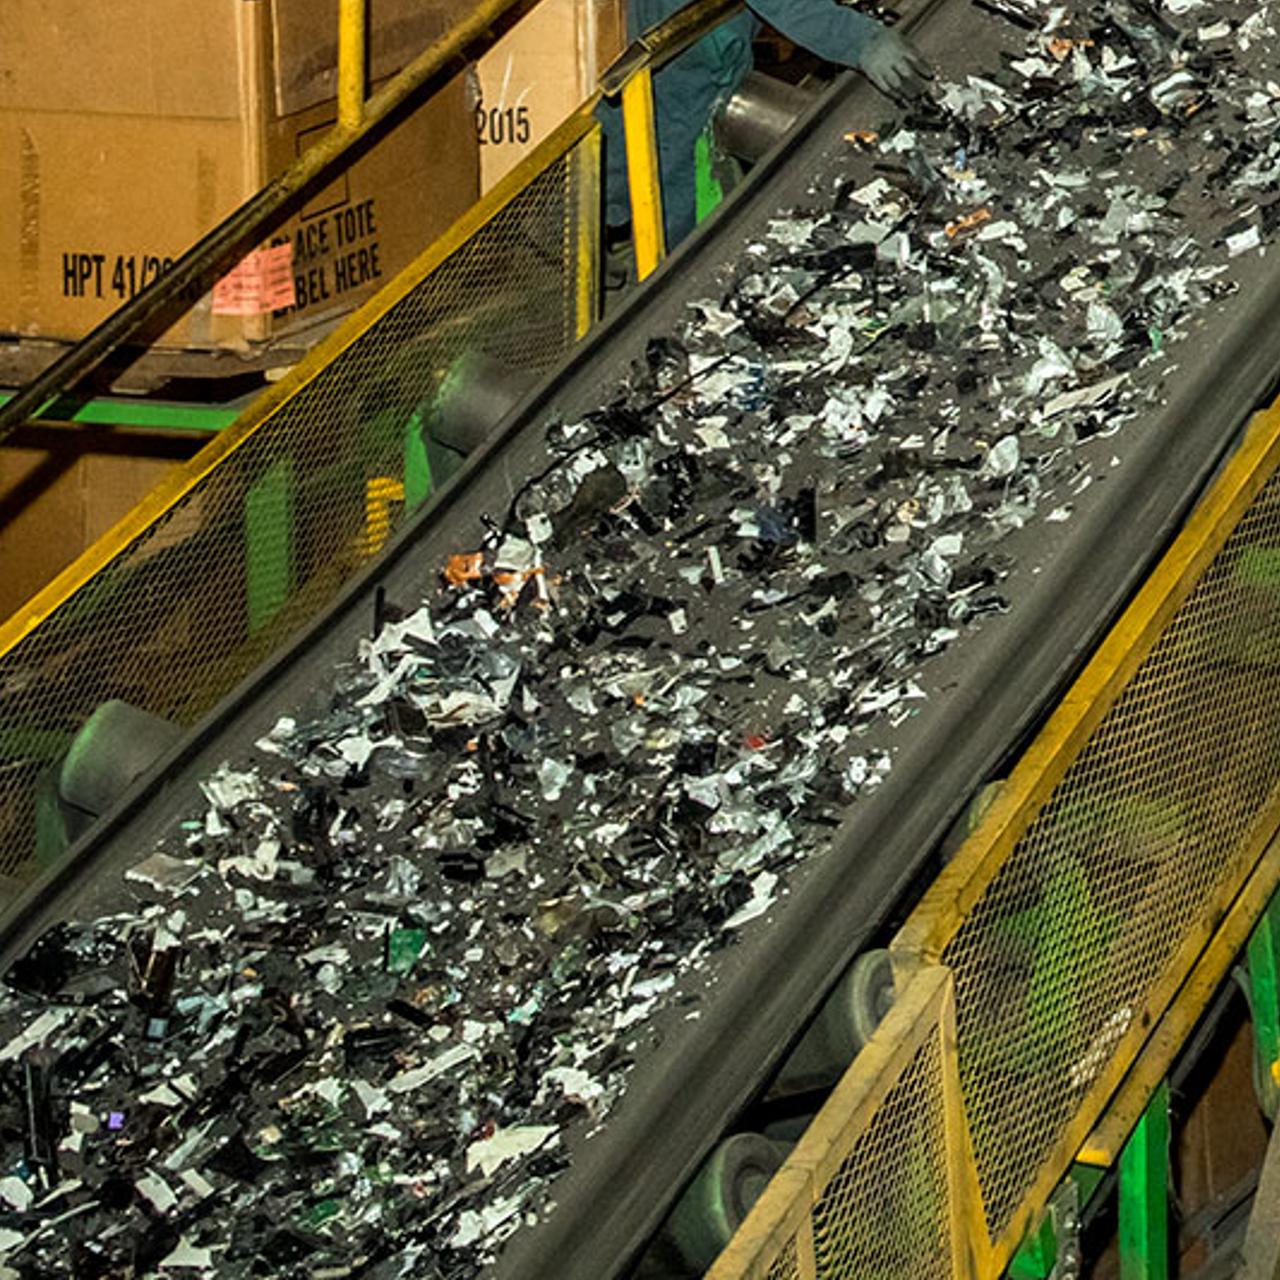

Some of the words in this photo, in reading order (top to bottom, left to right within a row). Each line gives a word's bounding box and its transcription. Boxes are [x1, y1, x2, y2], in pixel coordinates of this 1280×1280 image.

[333, 199, 377, 247] TOTE
[62, 253, 105, 299] HPT
[336, 243, 383, 294] HERE
